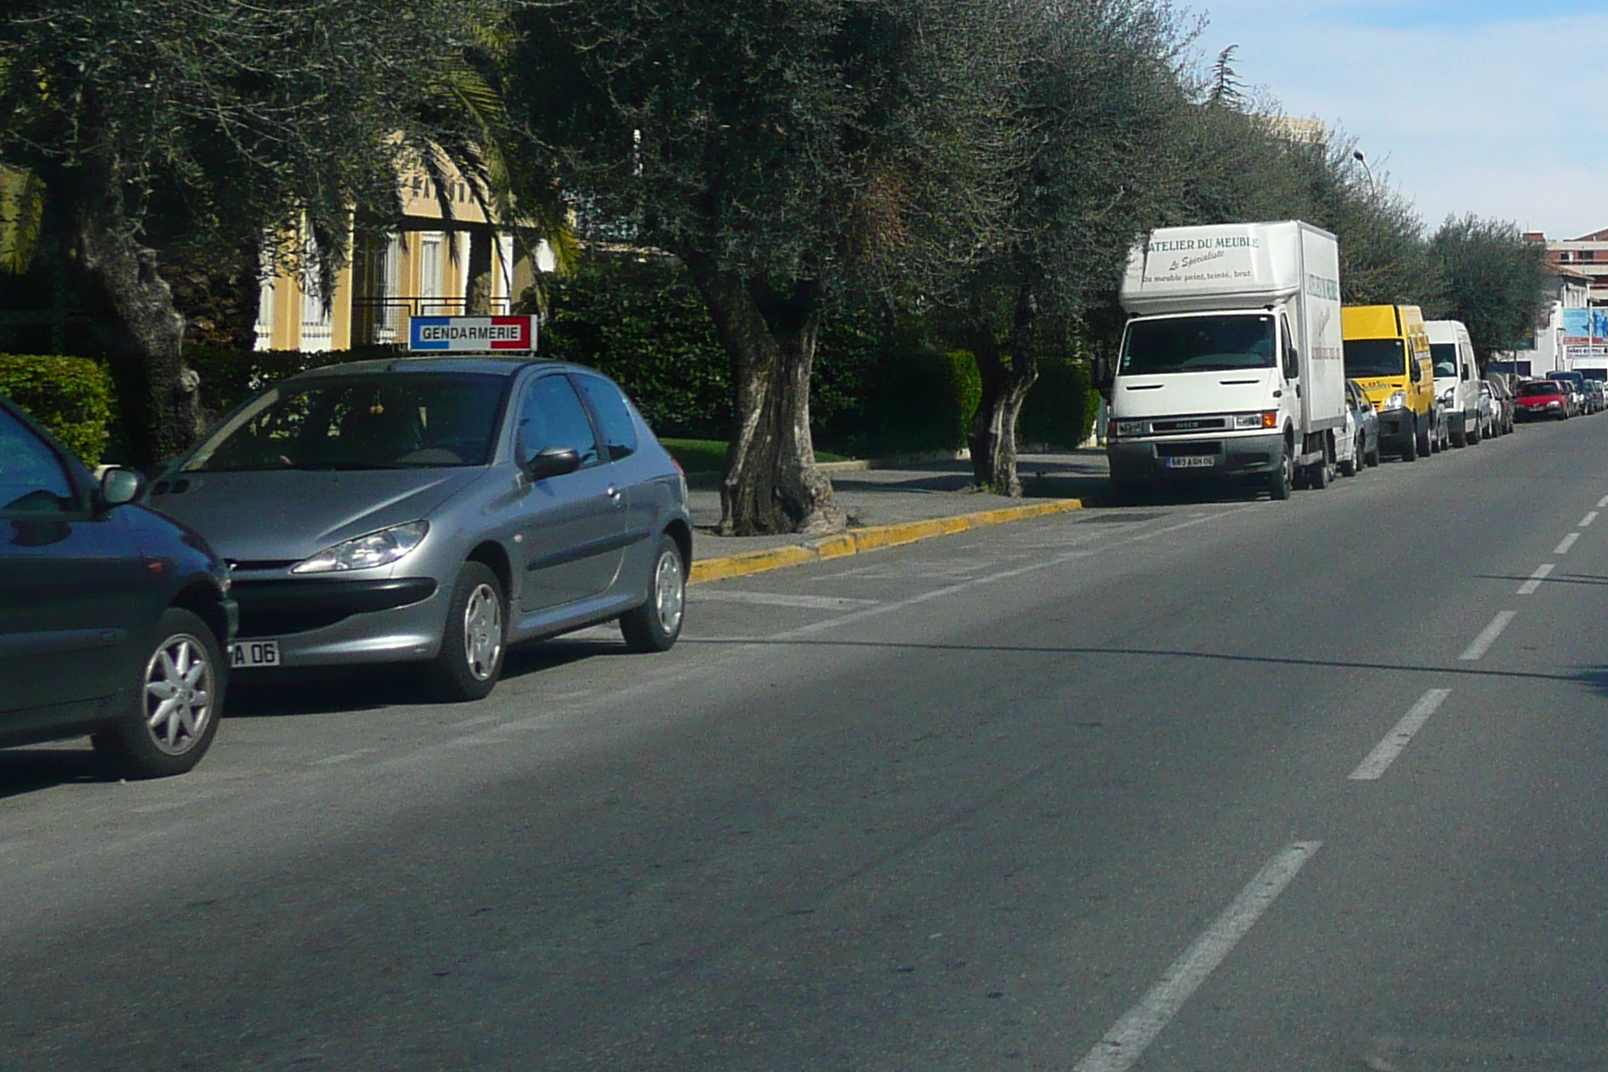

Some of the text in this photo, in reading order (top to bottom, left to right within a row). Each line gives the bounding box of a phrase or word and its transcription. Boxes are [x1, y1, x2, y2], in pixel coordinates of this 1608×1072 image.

[1197, 239, 1213, 249] DU
[1215, 236, 1260, 249] MEUBLE
[1154, 275, 1182, 283] meuble
[1233, 270, 1251, 278] brut
[422, 327, 519, 340] GENDARMERIE
[234, 643, 276, 665] A 06
